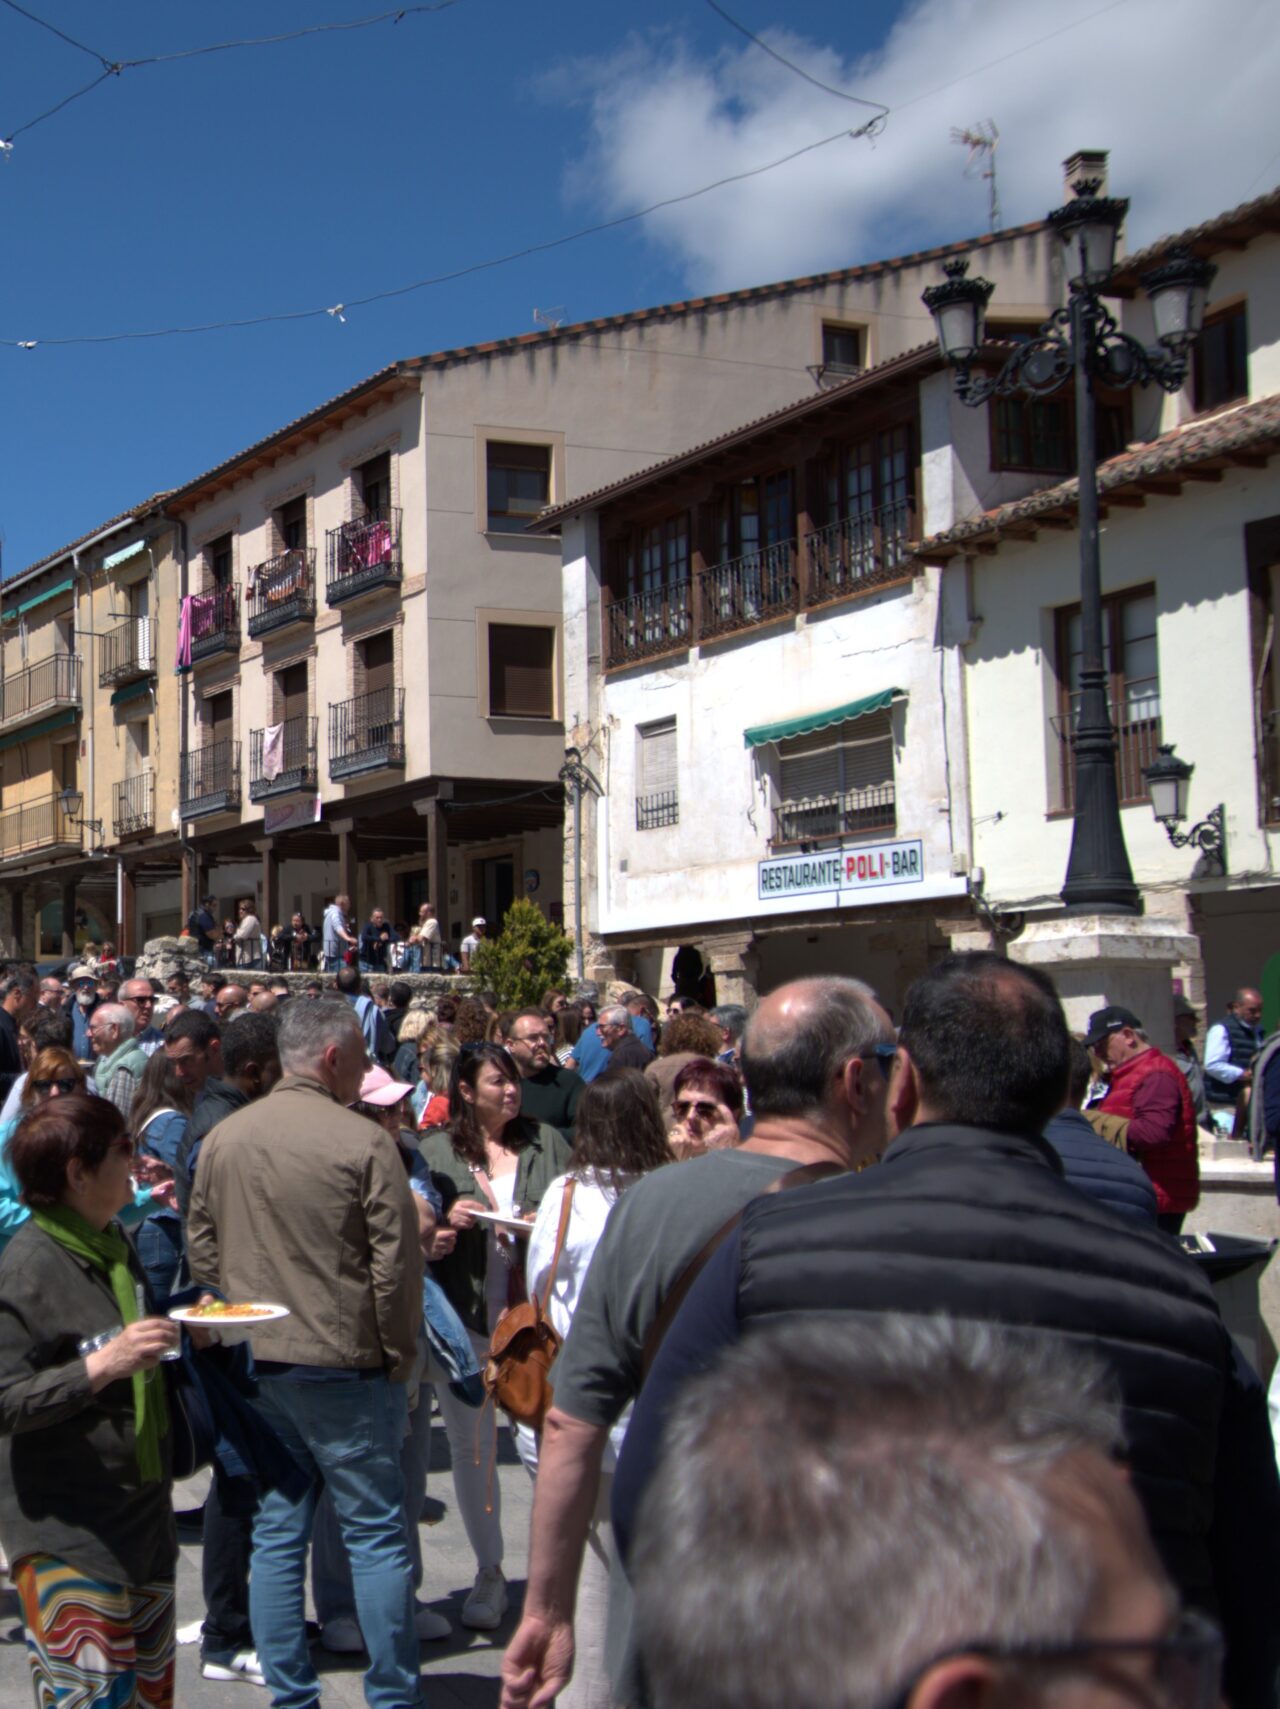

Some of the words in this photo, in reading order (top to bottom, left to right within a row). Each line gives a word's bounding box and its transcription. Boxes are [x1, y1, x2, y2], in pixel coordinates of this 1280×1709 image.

[761, 858, 840, 892] RESTAURANTE
[845, 852, 885, 881] POLI
[891, 848, 919, 876] BAR
